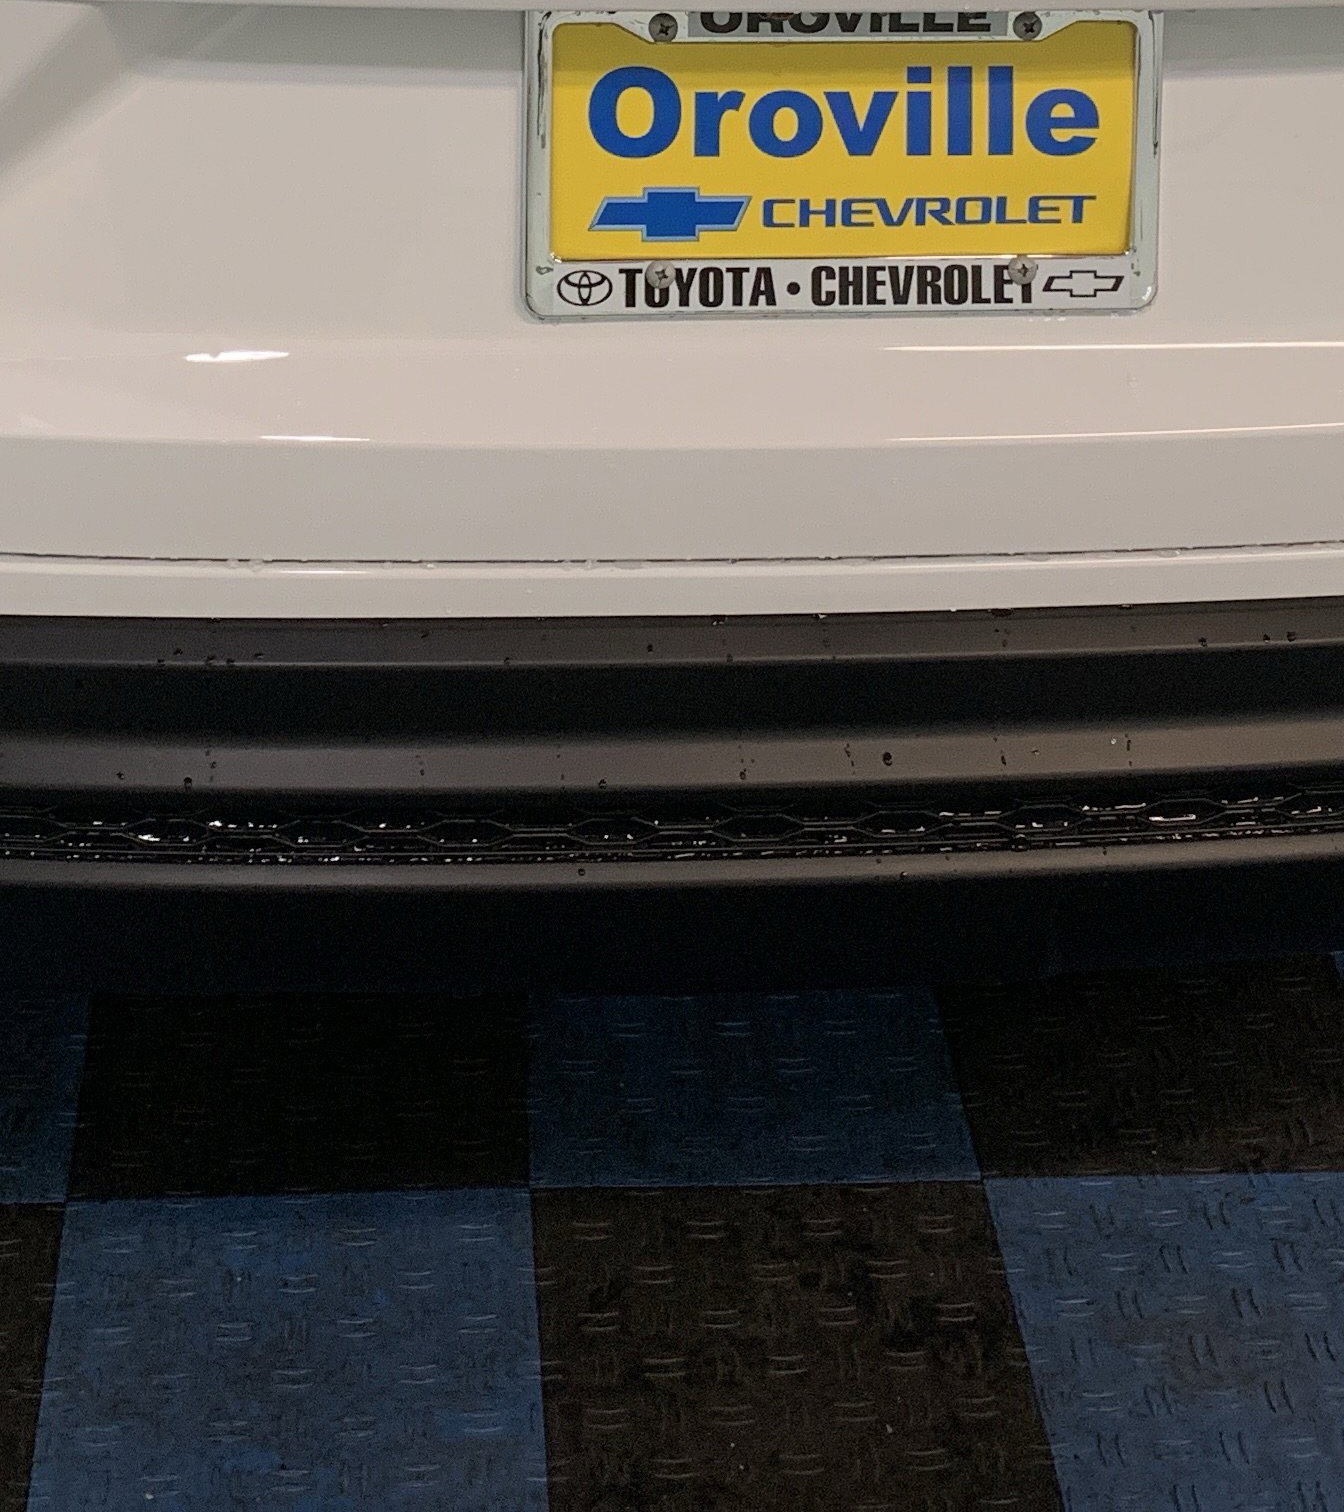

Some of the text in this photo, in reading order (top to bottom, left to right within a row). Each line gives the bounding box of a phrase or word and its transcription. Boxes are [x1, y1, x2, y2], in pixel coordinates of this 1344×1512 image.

[588, 65, 1100, 159] Oroville
[762, 196, 1097, 229] CHEVROLET
[619, 267, 777, 309] TOYOTA
